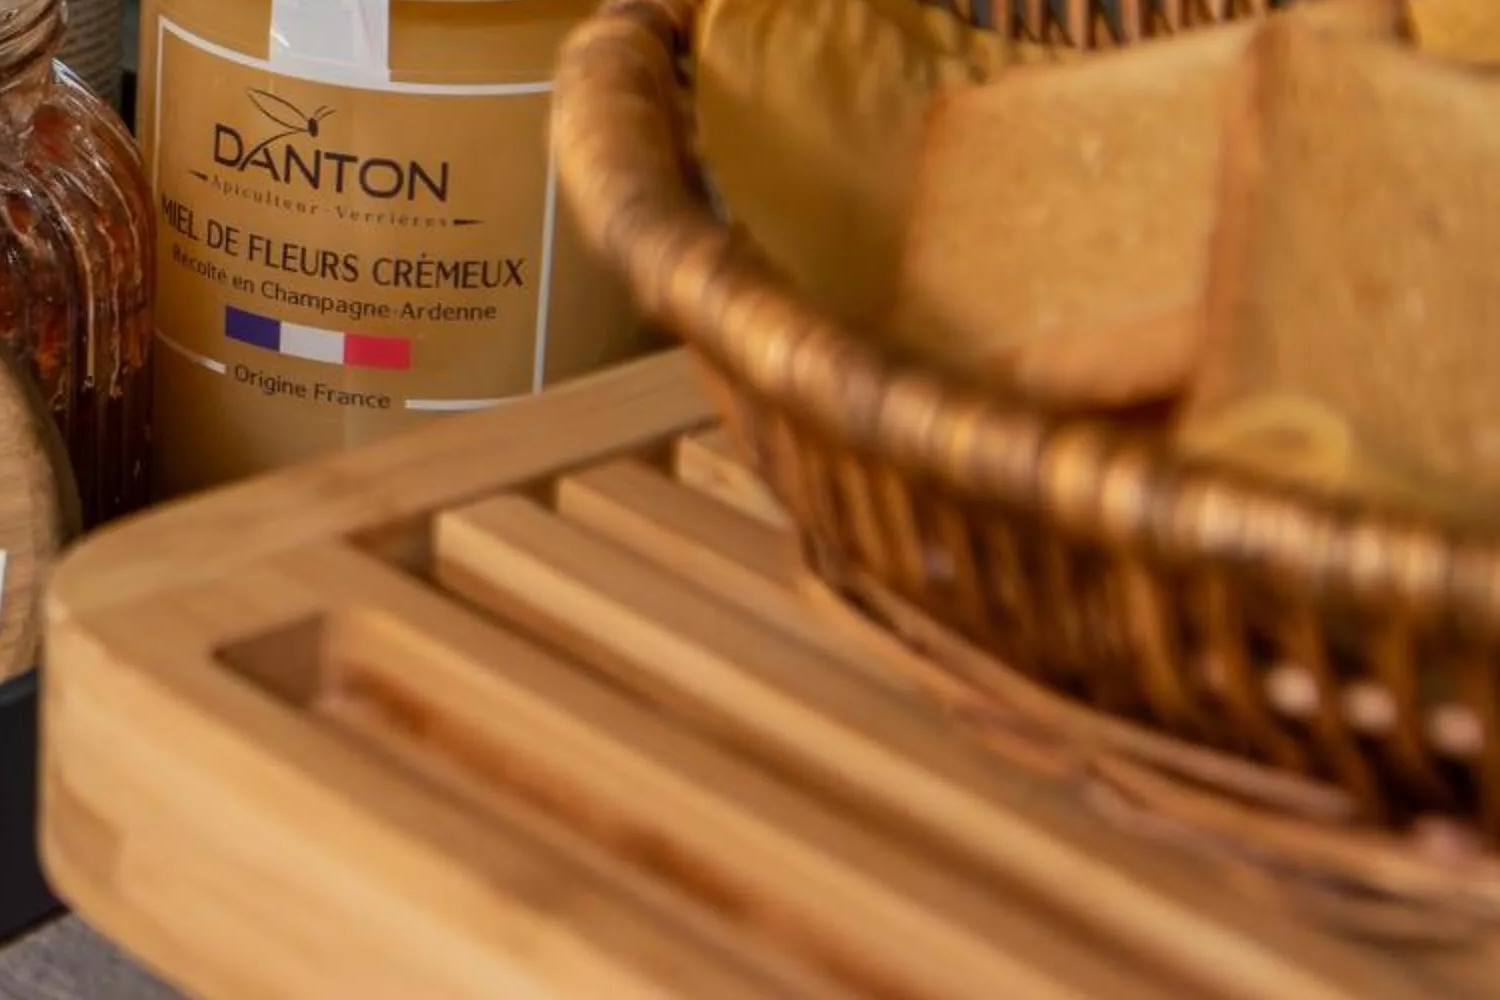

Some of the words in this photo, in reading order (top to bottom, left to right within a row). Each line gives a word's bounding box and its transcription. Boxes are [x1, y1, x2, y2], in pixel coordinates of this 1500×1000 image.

[214, 123, 449, 202] DANTON
[161, 193, 199, 242] MIEL
[206, 219, 241, 257] DE
[249, 233, 360, 283] FLEURS
[372, 252, 525, 290] CRÉMEUX
[232, 274, 255, 295] en
[234, 364, 307, 396] Origine
[313, 382, 392, 410] France
